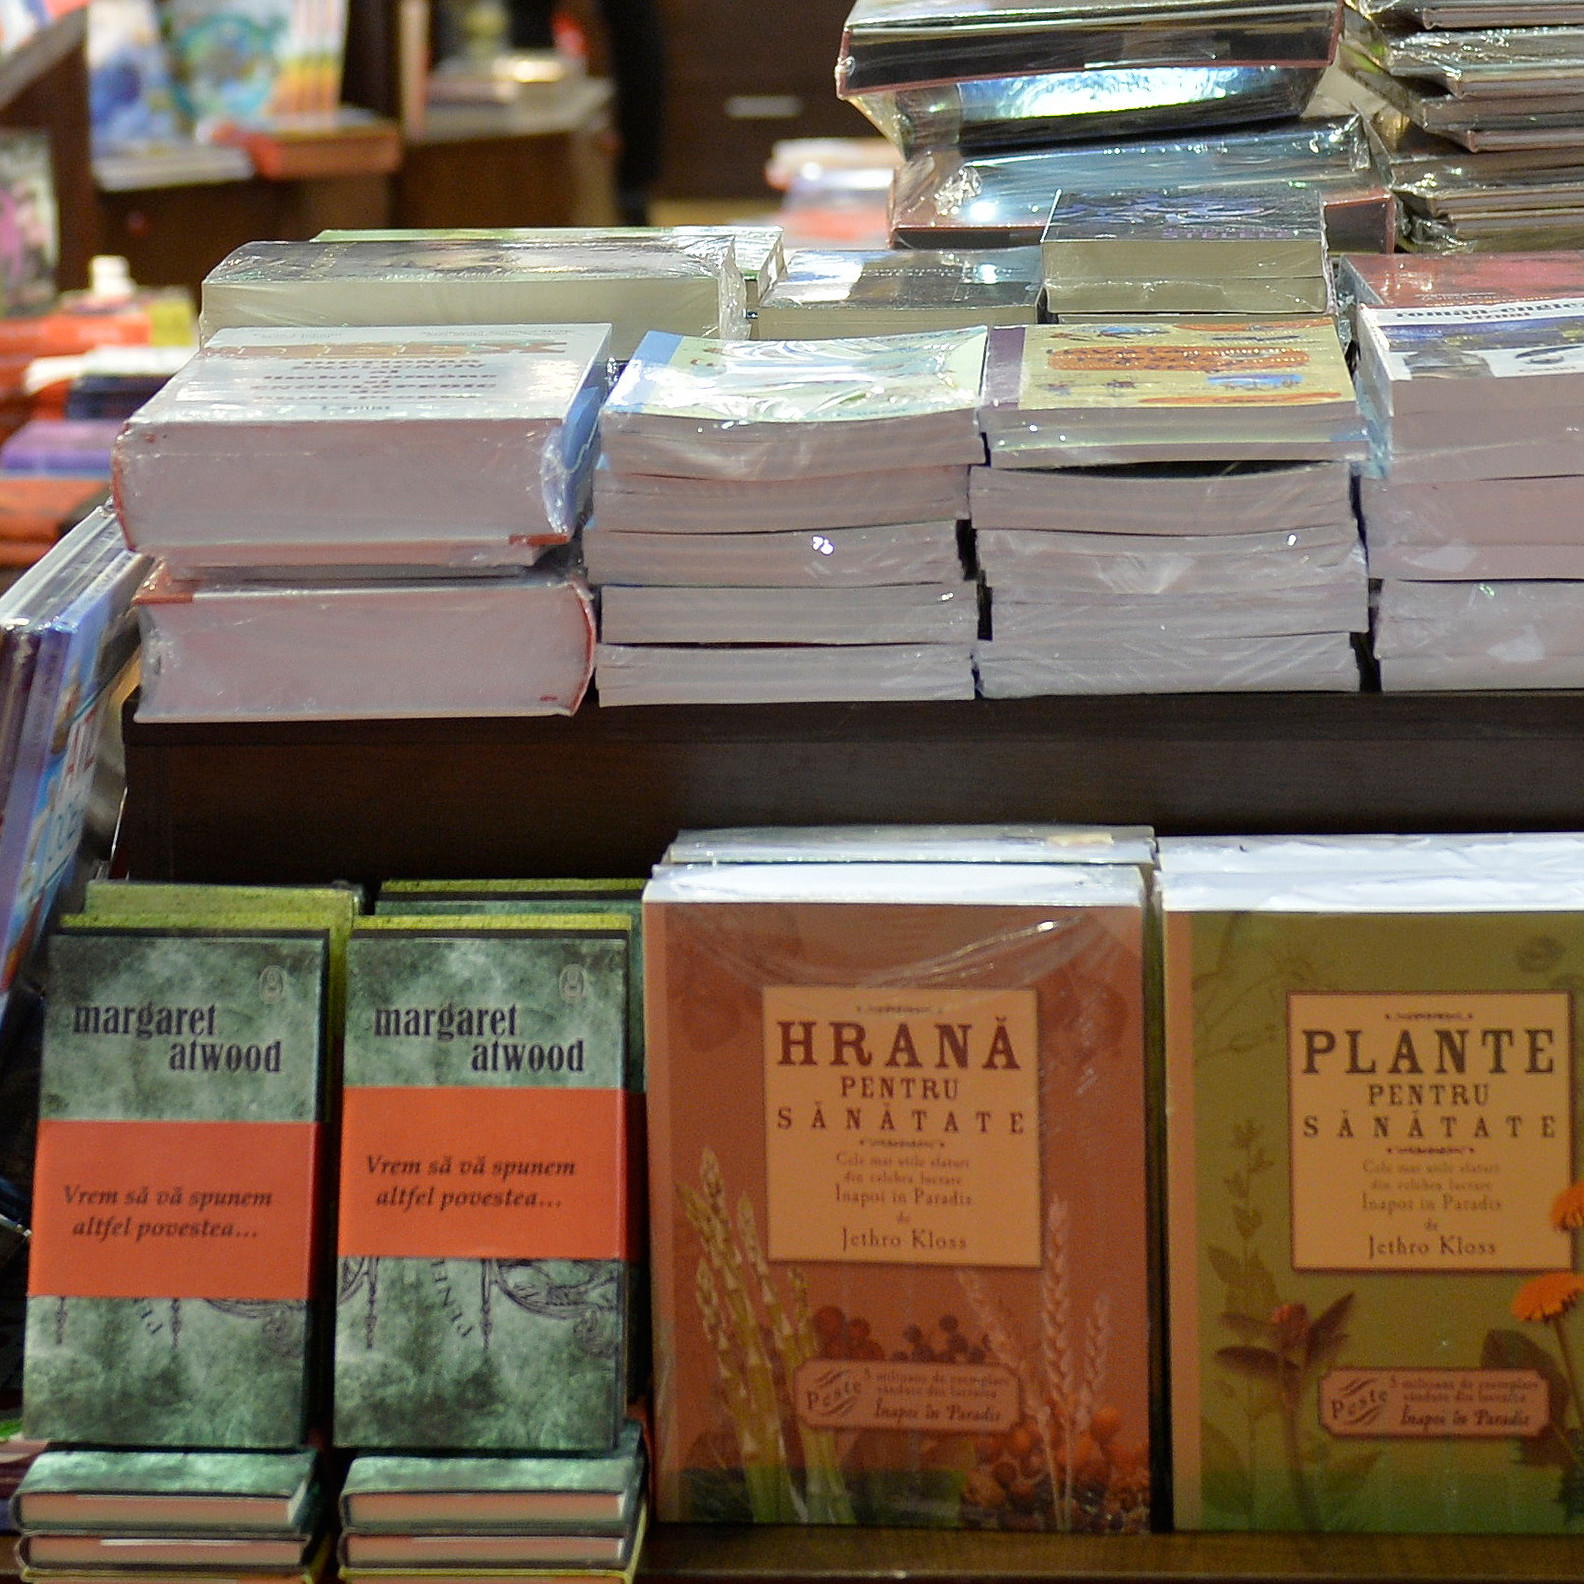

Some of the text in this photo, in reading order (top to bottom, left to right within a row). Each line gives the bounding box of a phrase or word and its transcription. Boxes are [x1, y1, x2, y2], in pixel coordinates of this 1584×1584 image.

[73, 1003, 216, 1041] margaret
[375, 1003, 517, 1041] margaret
[471, 1039, 584, 1073] atwood
[776, 1016, 1022, 1070] HRANĂ
[1301, 1028, 1555, 1075] PLANTE
[169, 1041, 282, 1073] atwood
[840, 1076, 960, 1101] PENTRU
[1368, 1083, 1490, 1107] PENTRU
[776, 1101, 1025, 1135] SĂNĂTATE
[1303, 1109, 1556, 1139] SĂNĂTATE
[366, 1155, 575, 1182] Vrem să vă spunem
[63, 1185, 272, 1213] Vrem să vă spunem
[376, 1186, 562, 1212] altfel povestea...
[913, 1186, 972, 1206] Paradis
[1442, 1192, 1503, 1211] Paradis
[72, 1216, 258, 1243] altfel povestea...
[841, 1227, 968, 1252] Jethro Kloss
[1368, 1234, 1498, 1260] Jethro Kloss
